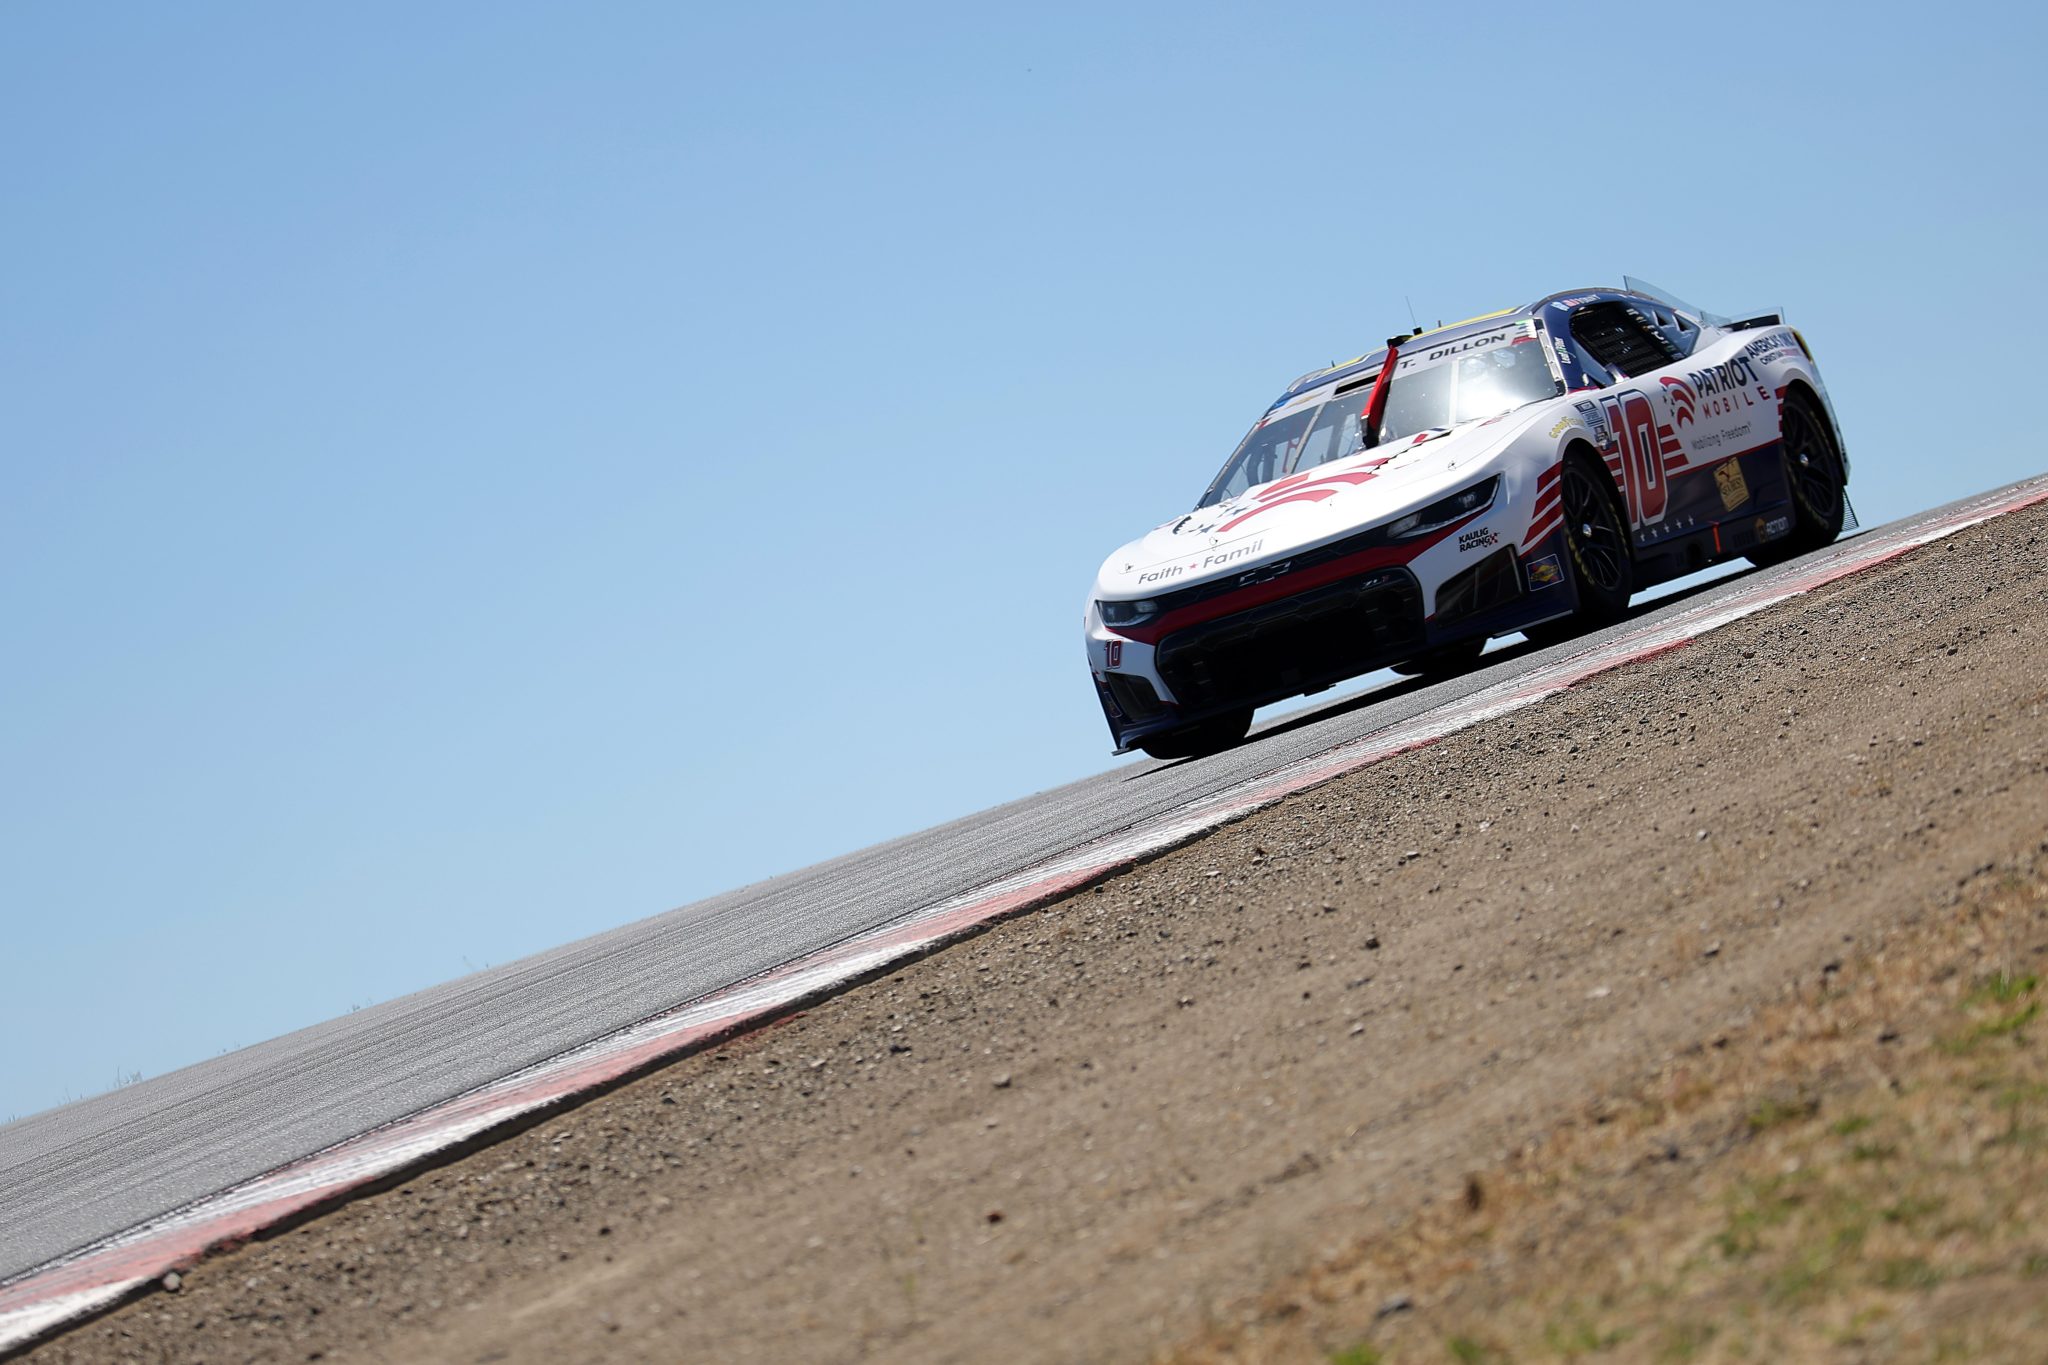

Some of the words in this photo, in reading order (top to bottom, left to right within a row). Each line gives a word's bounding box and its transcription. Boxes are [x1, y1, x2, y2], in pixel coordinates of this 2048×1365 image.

[1400, 359, 1416, 369] T.
[1429, 333, 1506, 361] DILLON
[1687, 356, 1759, 398] PATRIOT
[1702, 385, 1770, 419] MOBILE
[1598, 388, 1668, 533] 10
[1458, 526, 1489, 544] KAULIG
[1459, 534, 1491, 553] RACING
[1138, 565, 1184, 584] Faith
[1104, 639, 1121, 670] 10
